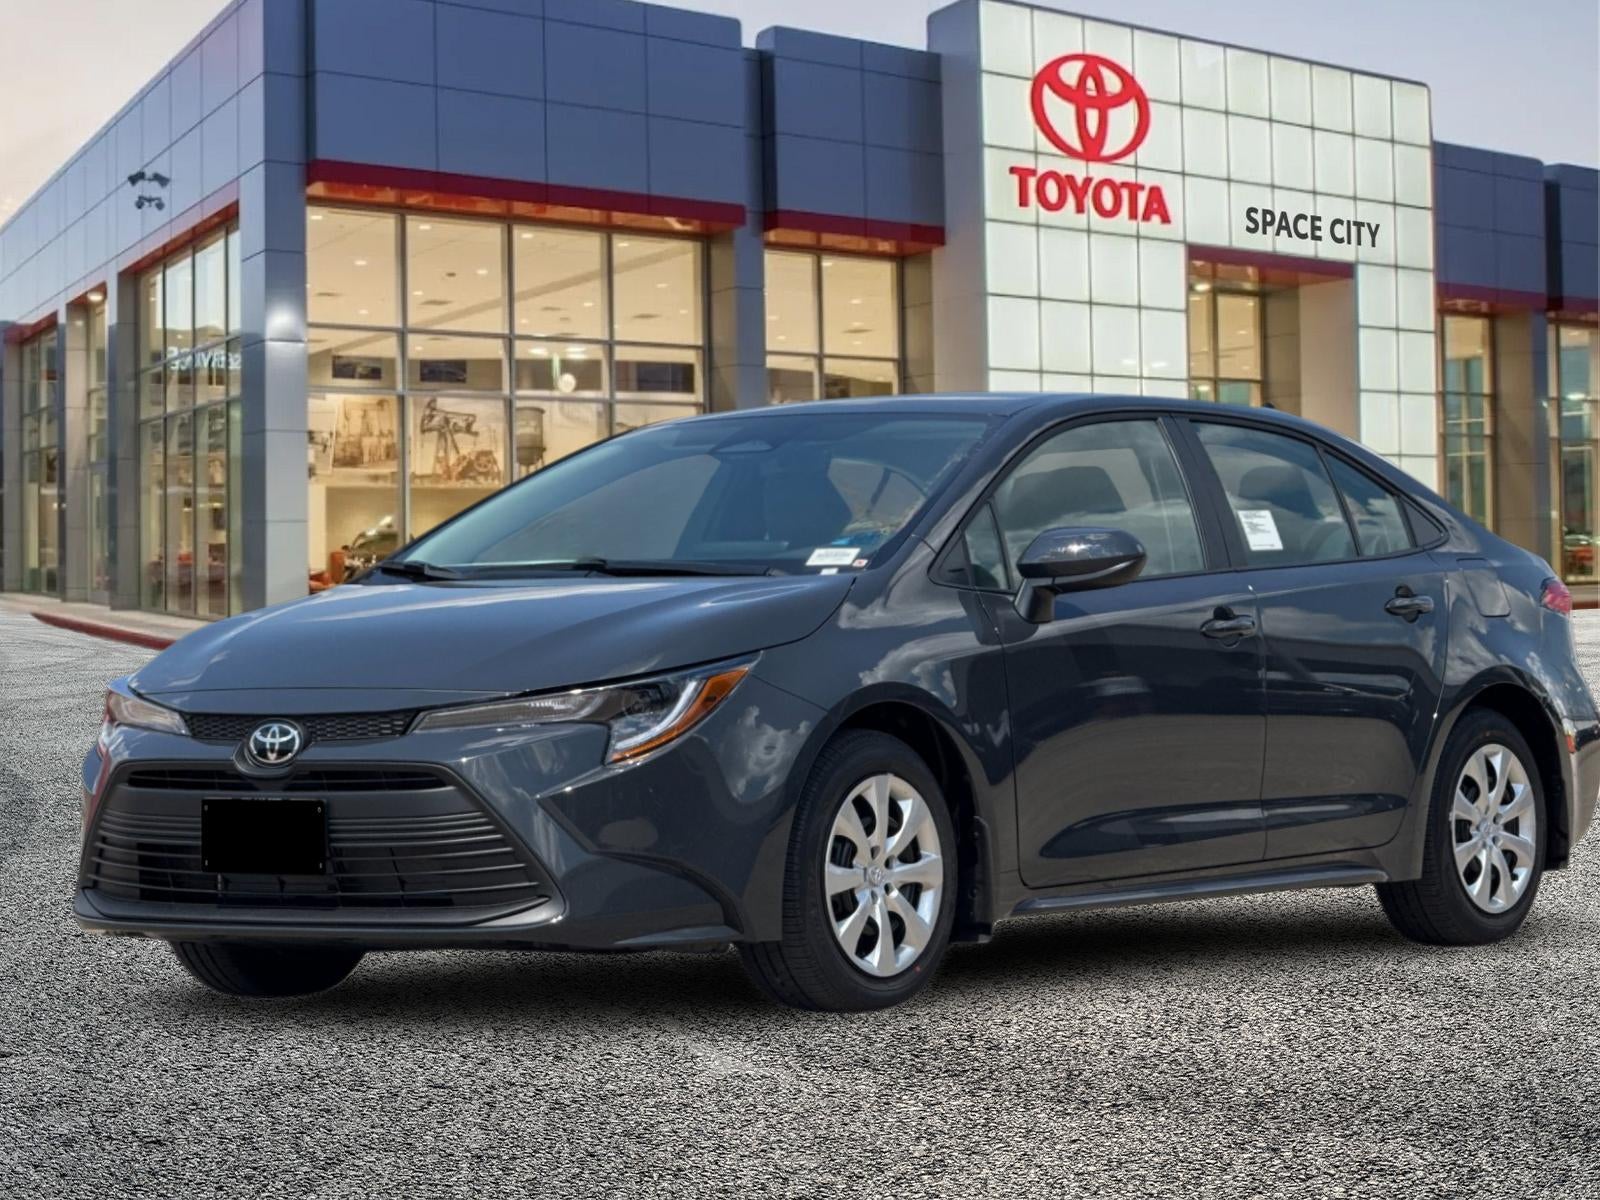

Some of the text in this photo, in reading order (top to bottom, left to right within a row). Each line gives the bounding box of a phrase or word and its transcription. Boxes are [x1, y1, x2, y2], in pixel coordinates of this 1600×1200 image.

[1009, 166, 1171, 224] TOYOTA
[1245, 206, 1380, 248] SPACE CITY
